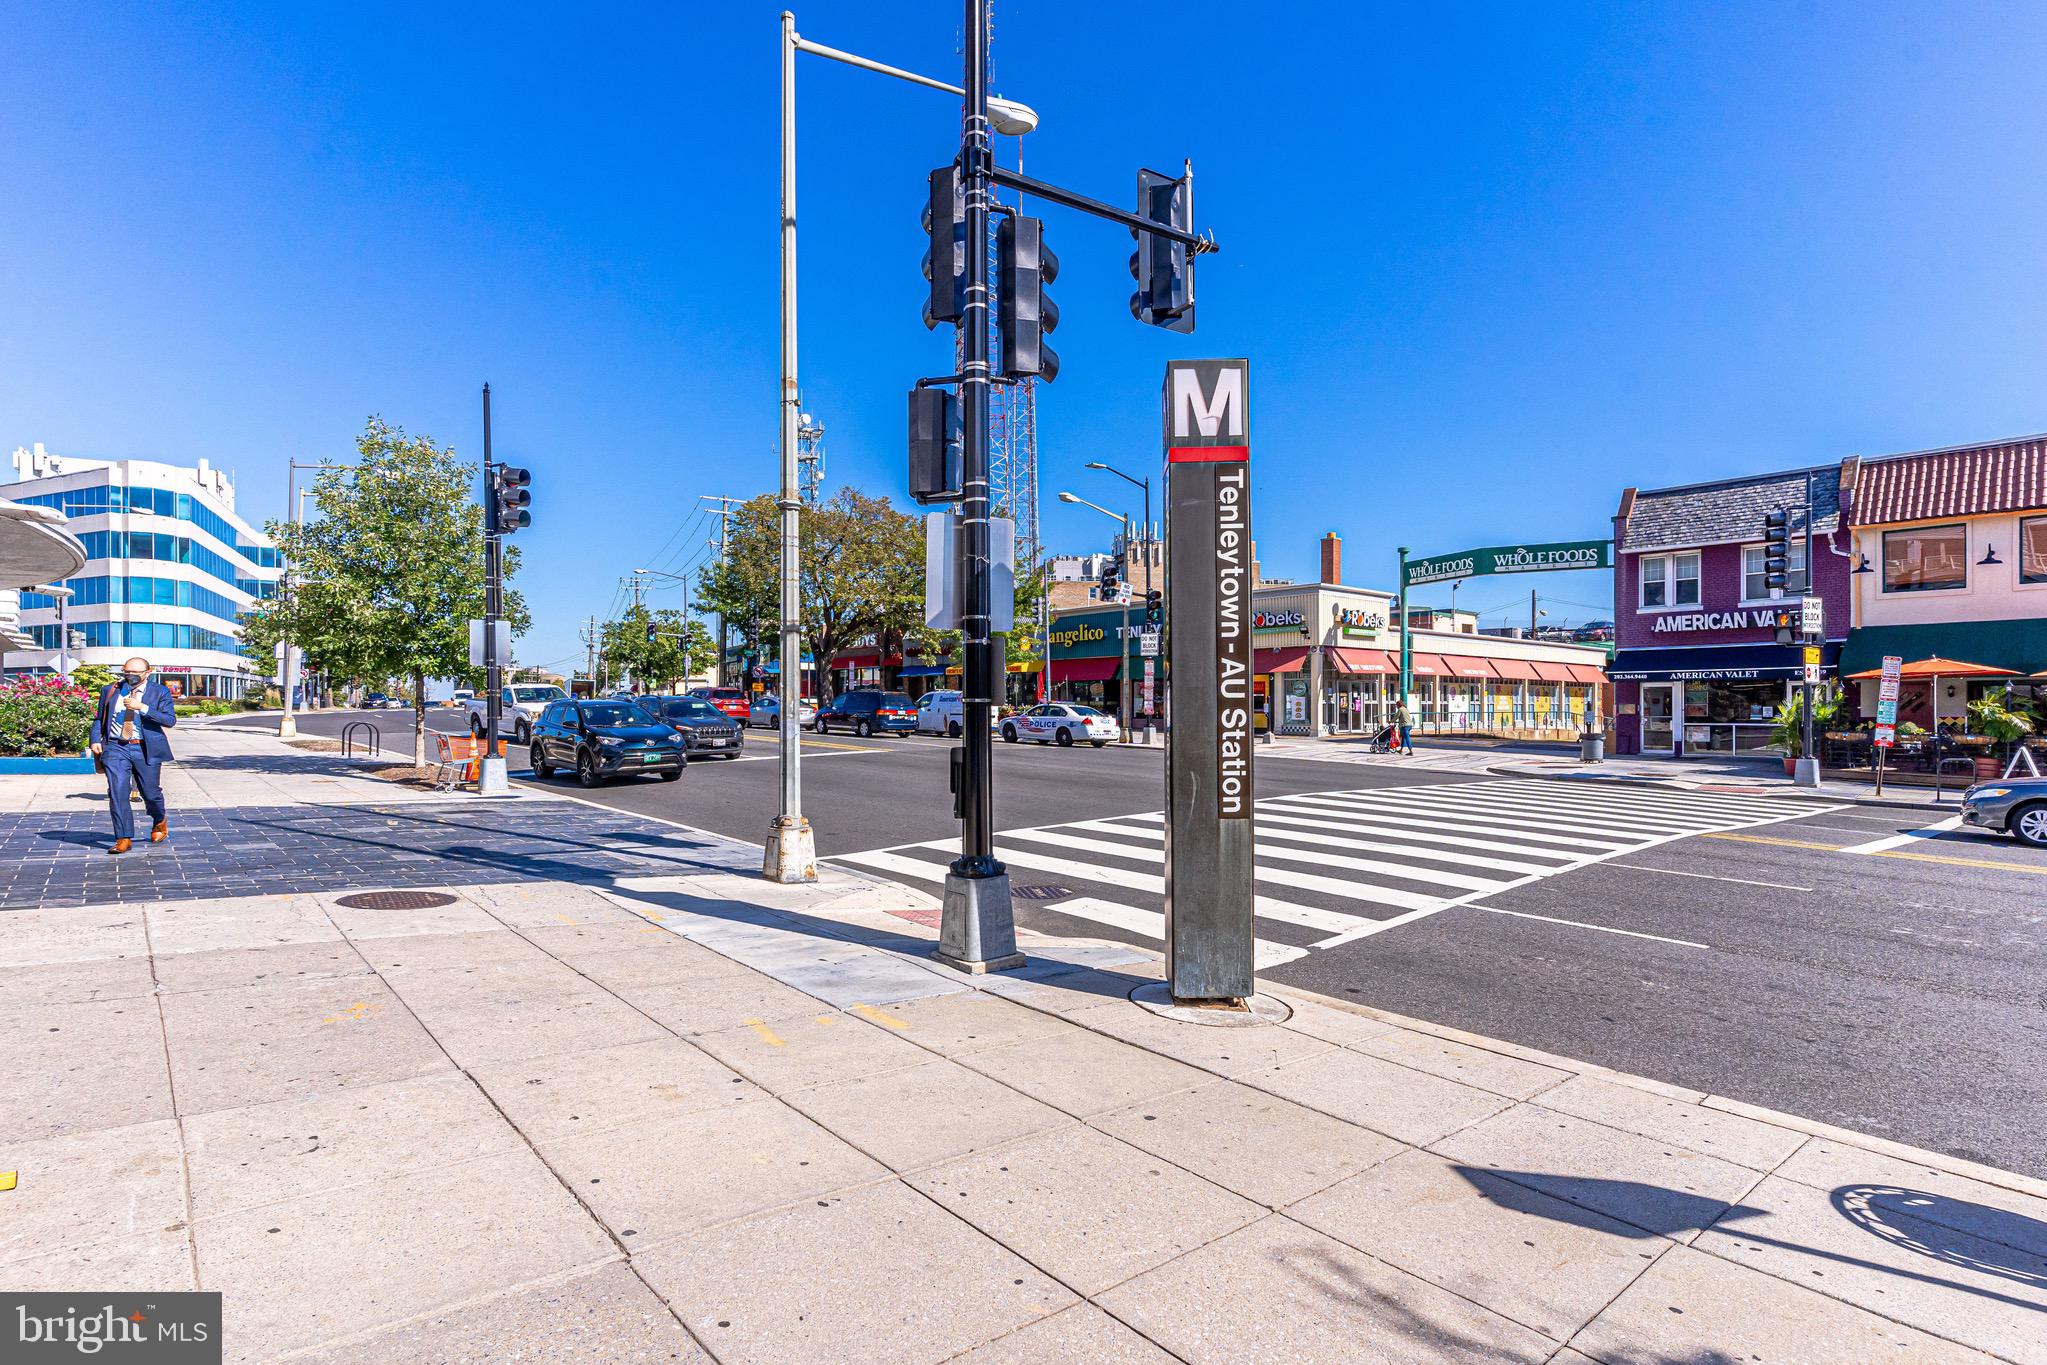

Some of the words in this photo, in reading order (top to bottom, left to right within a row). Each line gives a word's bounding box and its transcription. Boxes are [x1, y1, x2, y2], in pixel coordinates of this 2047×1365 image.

[1174, 368, 1243, 437] M
[1494, 548, 1547, 567] WHOLE
[1548, 548, 1598, 564] FOODS
[1408, 561, 1442, 579] WHOLE
[1442, 558, 1474, 574] FOODS
[1804, 601, 1811, 610] DO
[1812, 602, 1821, 611] NOT
[1351, 610, 1385, 629] Robeks
[1654, 611, 1748, 633] AMERICAN
[1804, 612, 1820, 621] BLOCK
[1049, 623, 1104, 648] angelico
[1669, 671, 1723, 680] AMERICAN
[1723, 670, 1759, 679] VALET
[1029, 719, 1057, 728] POLICE
[1220, 708, 1248, 813] Station
